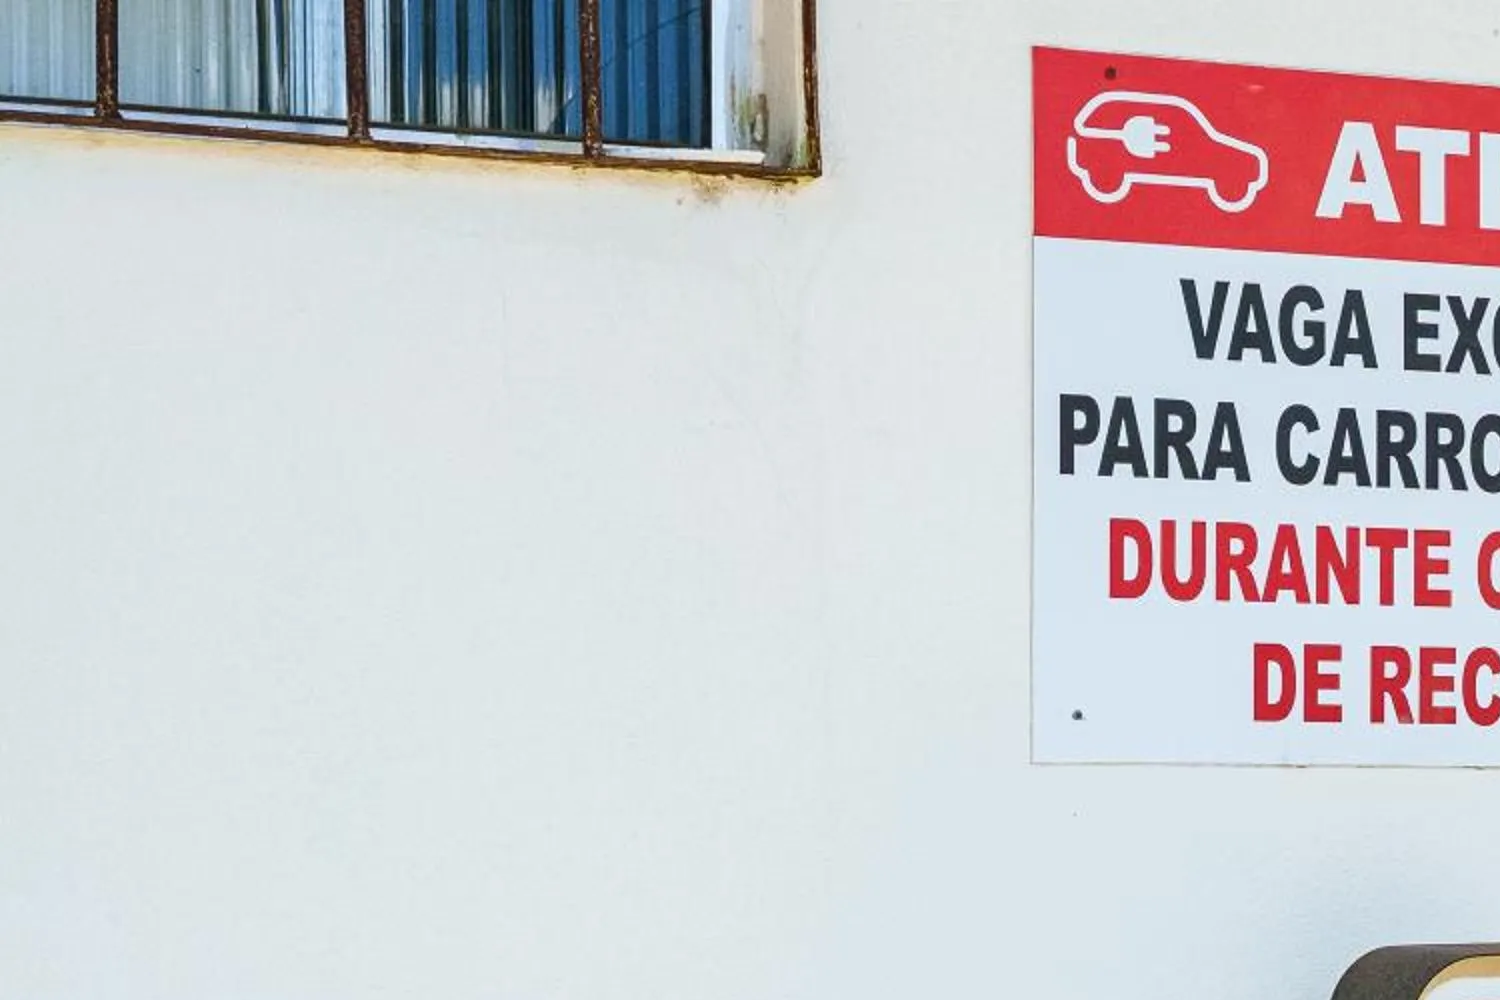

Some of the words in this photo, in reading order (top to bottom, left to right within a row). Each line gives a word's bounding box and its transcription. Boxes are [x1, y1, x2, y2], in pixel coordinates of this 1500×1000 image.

[1180, 278, 1379, 369] VAGA
[1060, 393, 1251, 482] PARA
[1109, 518, 1453, 607] DURANTE
[1252, 642, 1343, 723] DE
